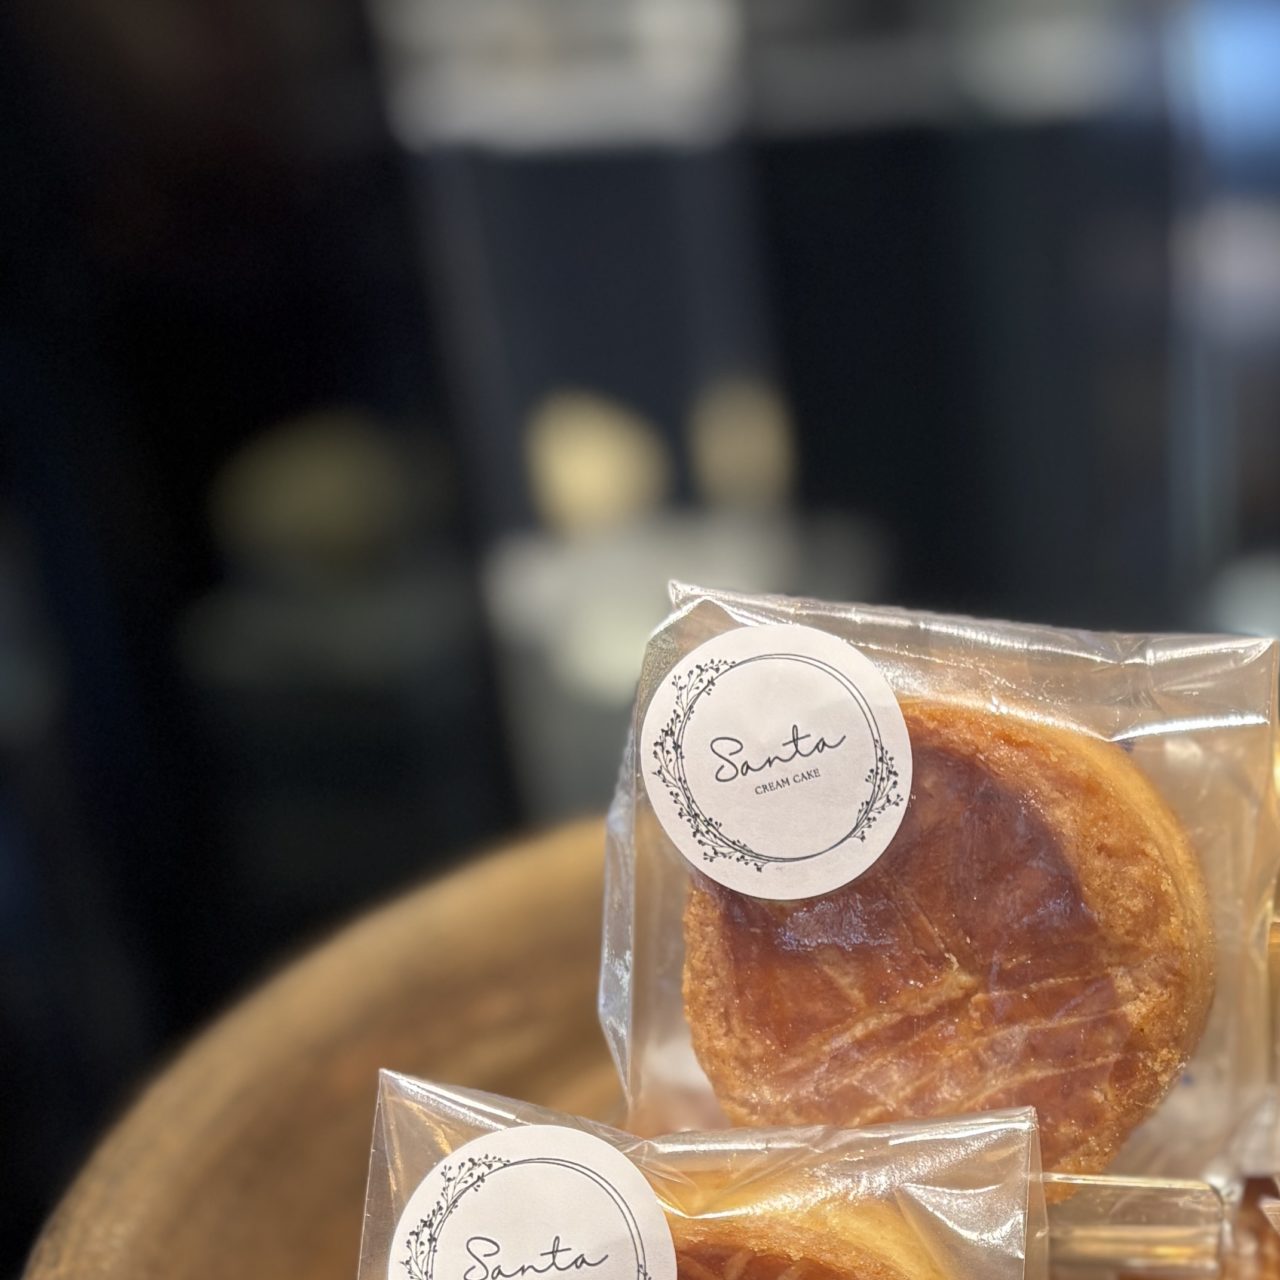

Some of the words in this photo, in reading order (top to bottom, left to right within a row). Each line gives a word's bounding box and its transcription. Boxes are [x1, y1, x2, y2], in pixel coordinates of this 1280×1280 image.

[709, 724, 847, 783] Santa
[754, 776, 791, 796] CREAM
[792, 768, 821, 785] CAKE
